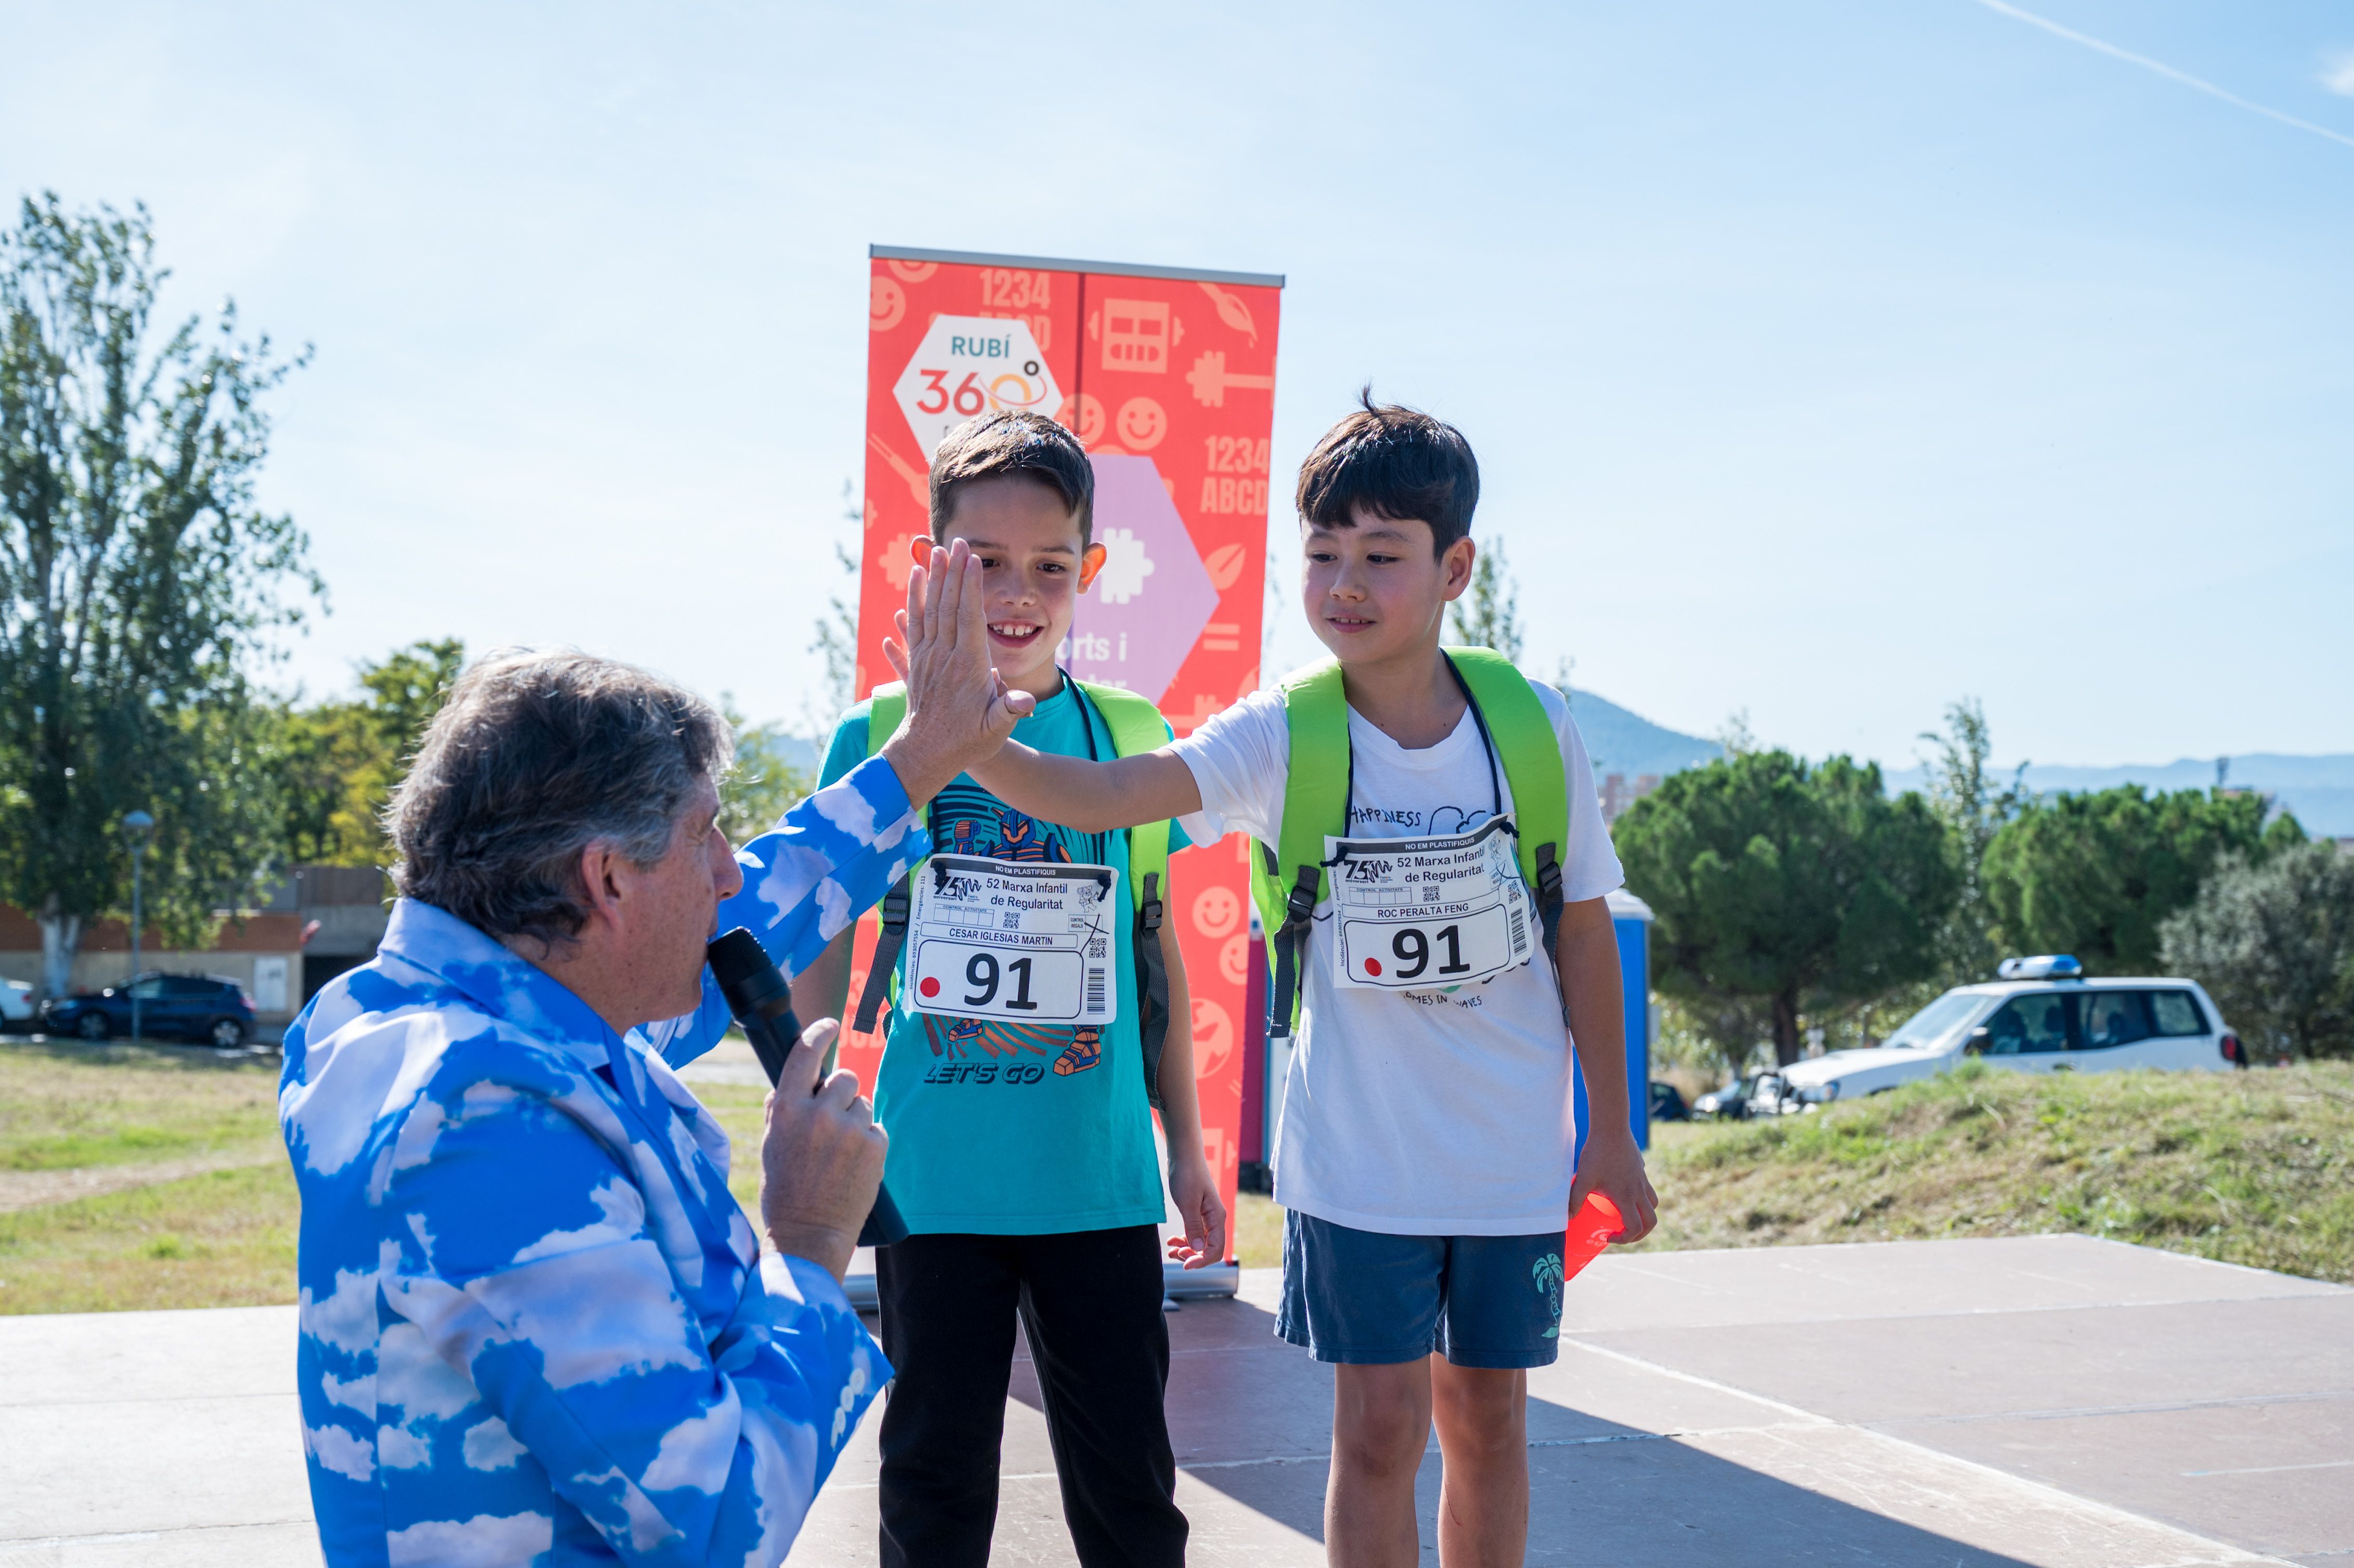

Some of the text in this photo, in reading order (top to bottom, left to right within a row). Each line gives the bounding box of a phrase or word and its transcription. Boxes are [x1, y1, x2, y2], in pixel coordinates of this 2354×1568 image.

[979, 268, 1051, 310] 1234
[951, 334, 1011, 358] RUBÍ
[1204, 435, 1270, 475] 1234
[1199, 476, 1269, 516] ABCD
[1119, 632, 1128, 662] i
[1430, 837, 1475, 848] PLASTIFIQUIS
[1397, 844, 1485, 868] 52 Marxa Infantil
[1405, 862, 1485, 883] de Regularitat
[986, 878, 1068, 894] 52 Marxa Infantil
[990, 894, 1063, 911] de Regularitat
[1377, 903, 1469, 918] ROC PERALTA FENG
[949, 927, 1053, 945] CESAR IGLESIAS MARTIN
[1392, 924, 1470, 979] 91
[964, 952, 1038, 1010] 91
[1404, 991, 1482, 1009] OMES IN WAVES
[923, 1062, 1045, 1085] LET'S GO
